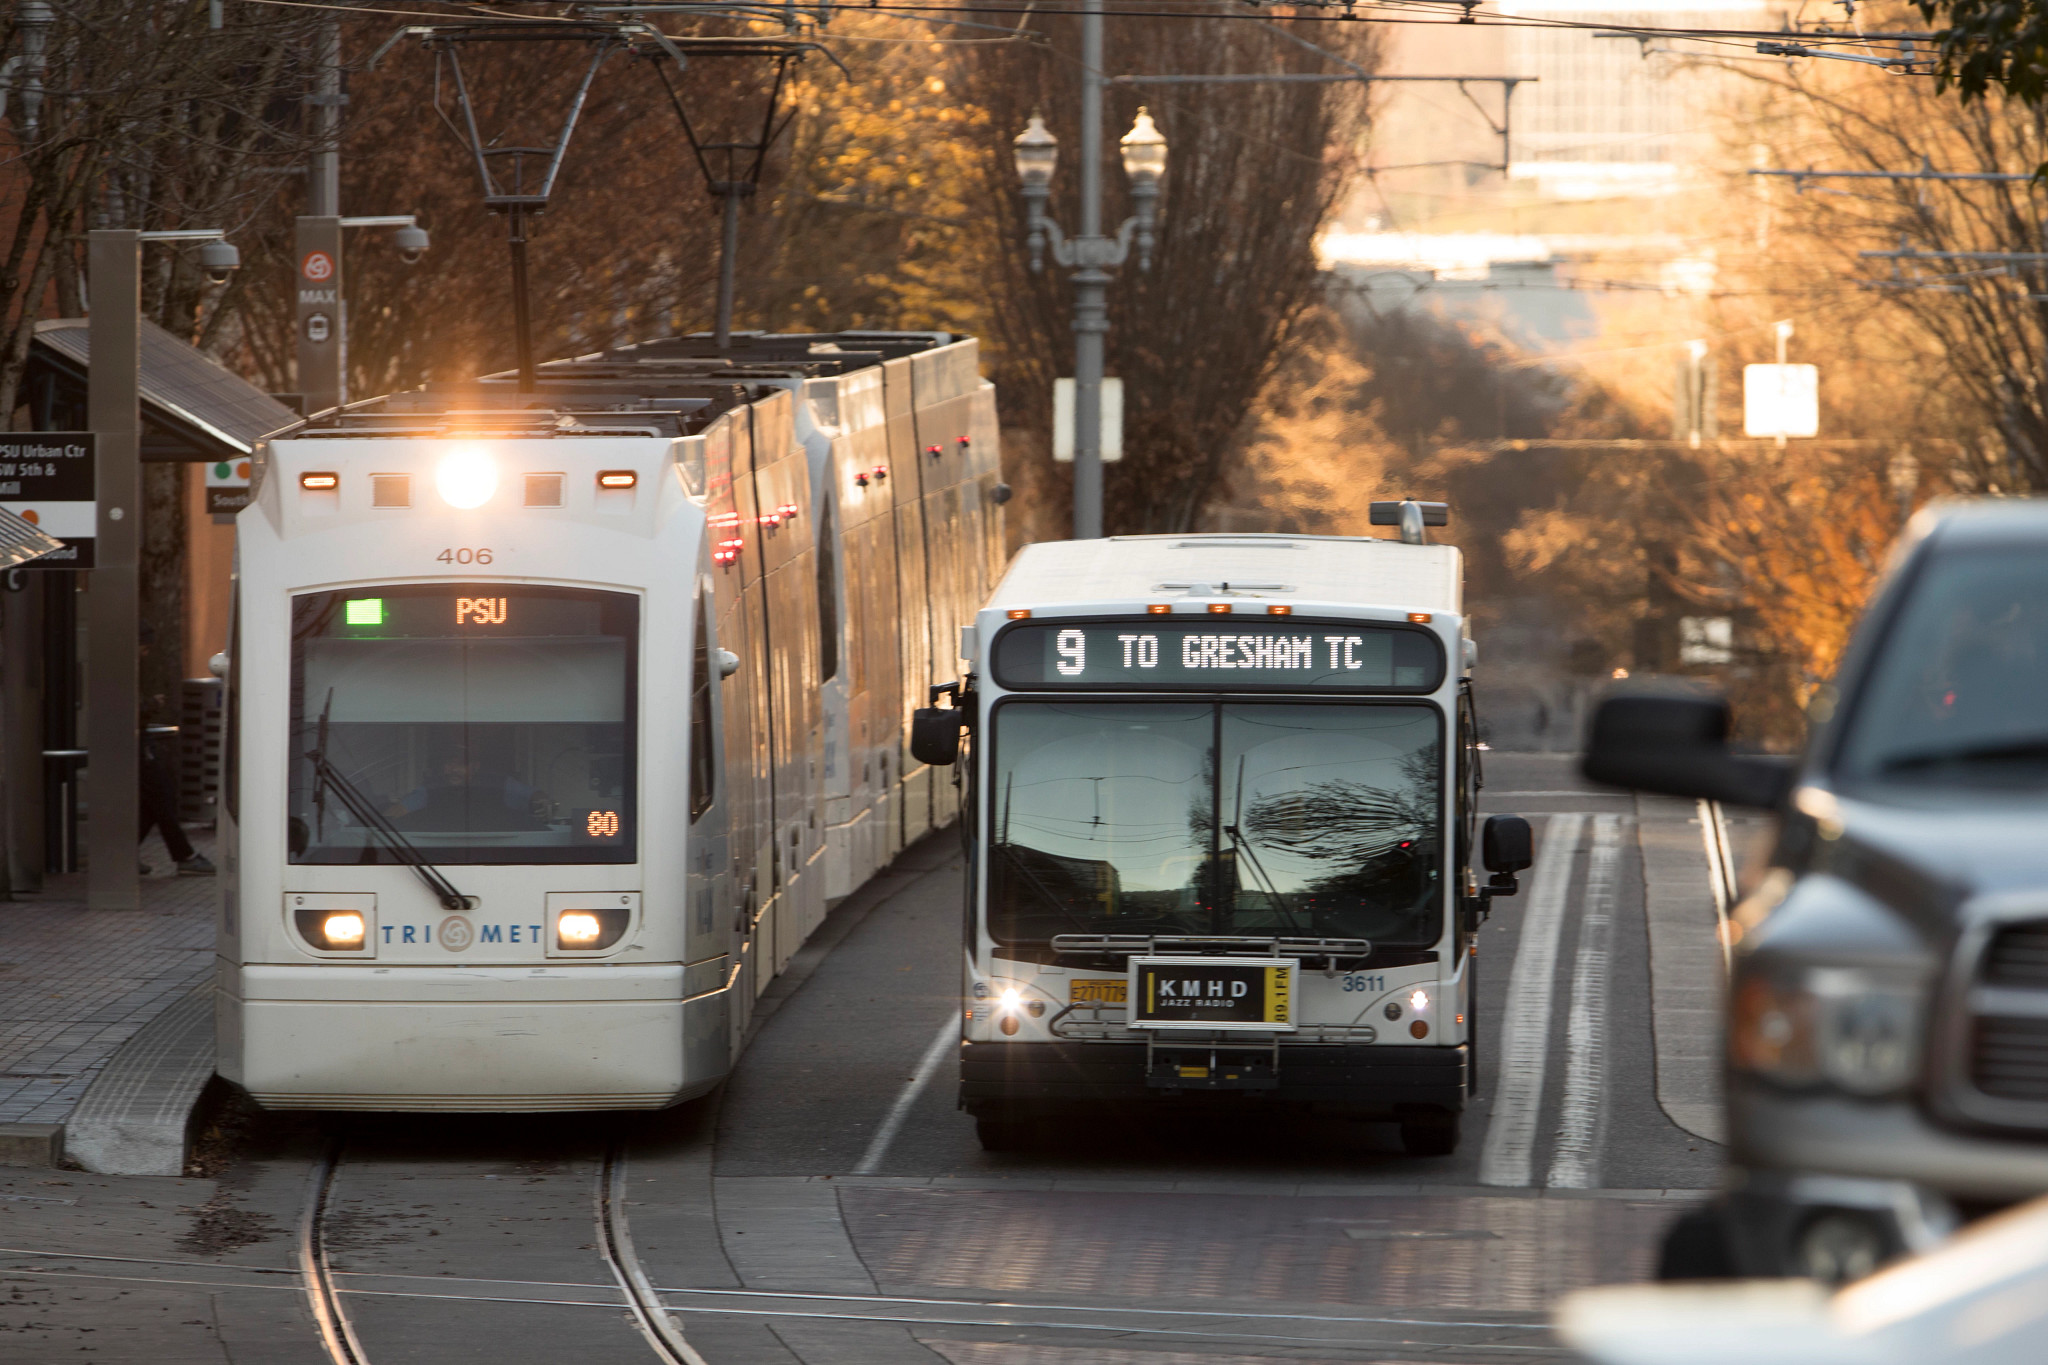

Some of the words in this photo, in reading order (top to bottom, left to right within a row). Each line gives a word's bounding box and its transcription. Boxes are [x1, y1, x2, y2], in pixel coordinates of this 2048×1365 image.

[299, 289, 336, 303] MAX
[22, 443, 63, 458] Urban
[64, 444, 87, 458] Ctr
[19, 462, 43, 476] 5th
[45, 463, 56, 476] &
[436, 548, 494, 565] 406
[456, 597, 507, 624] PSU
[1056, 629, 1085, 675] 9
[1117, 635, 1158, 668] TO
[1182, 635, 1312, 669] GRESHAM
[1324, 636, 1363, 669] TC
[381, 925, 431, 944] TRI
[480, 924, 542, 943] MET
[1160, 979, 1248, 997] KMHD
[1342, 975, 1384, 992] 3611
[1160, 999, 1191, 1007] JAZZ
[1195, 999, 1235, 1007] RADIO
